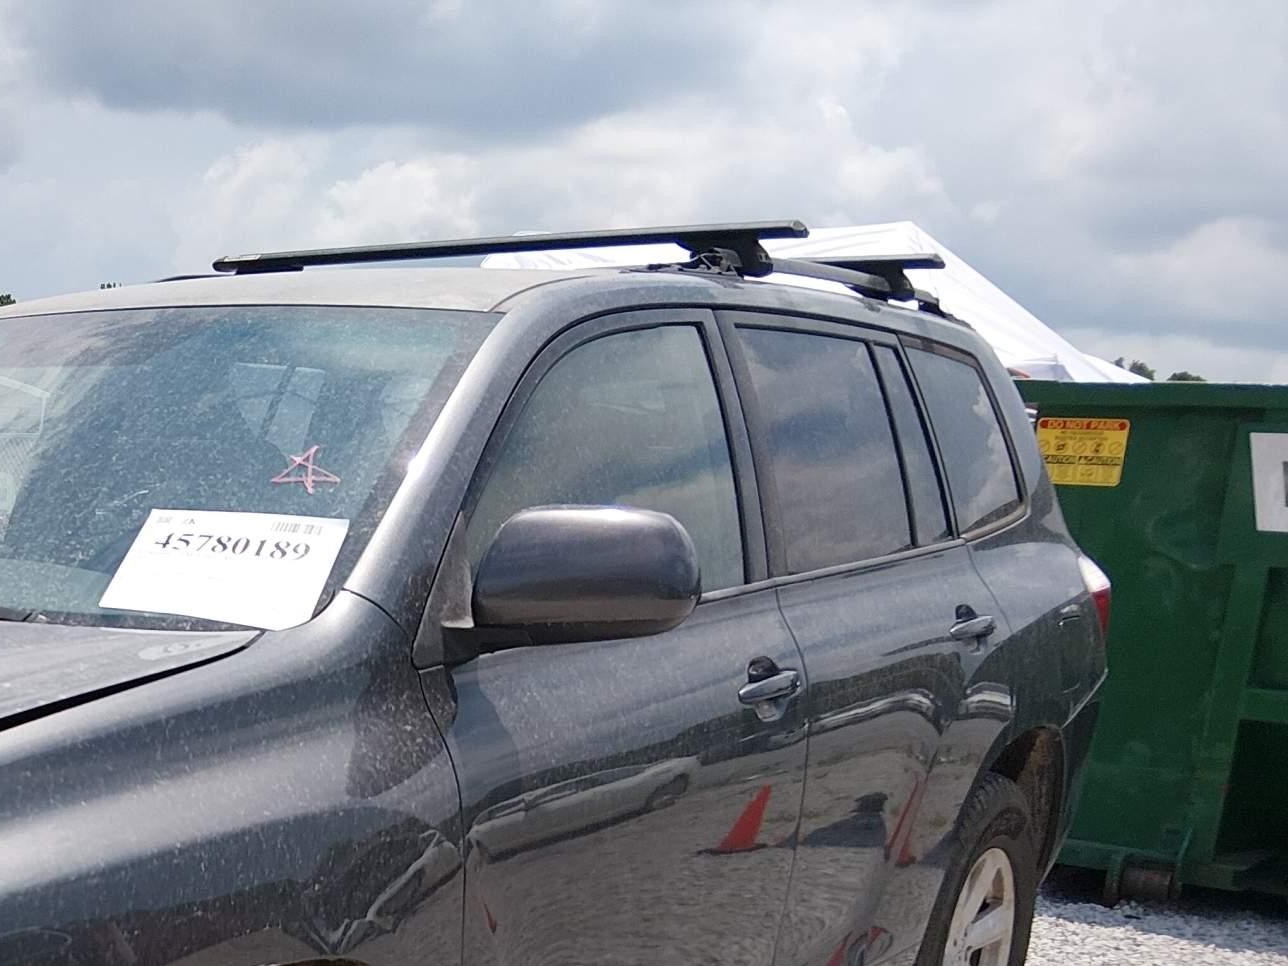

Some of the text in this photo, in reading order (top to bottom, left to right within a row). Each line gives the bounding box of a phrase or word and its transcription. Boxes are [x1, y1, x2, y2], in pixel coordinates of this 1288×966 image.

[1048, 420, 1120, 430] DO NOT PARK
[155, 532, 311, 560] 45780189
